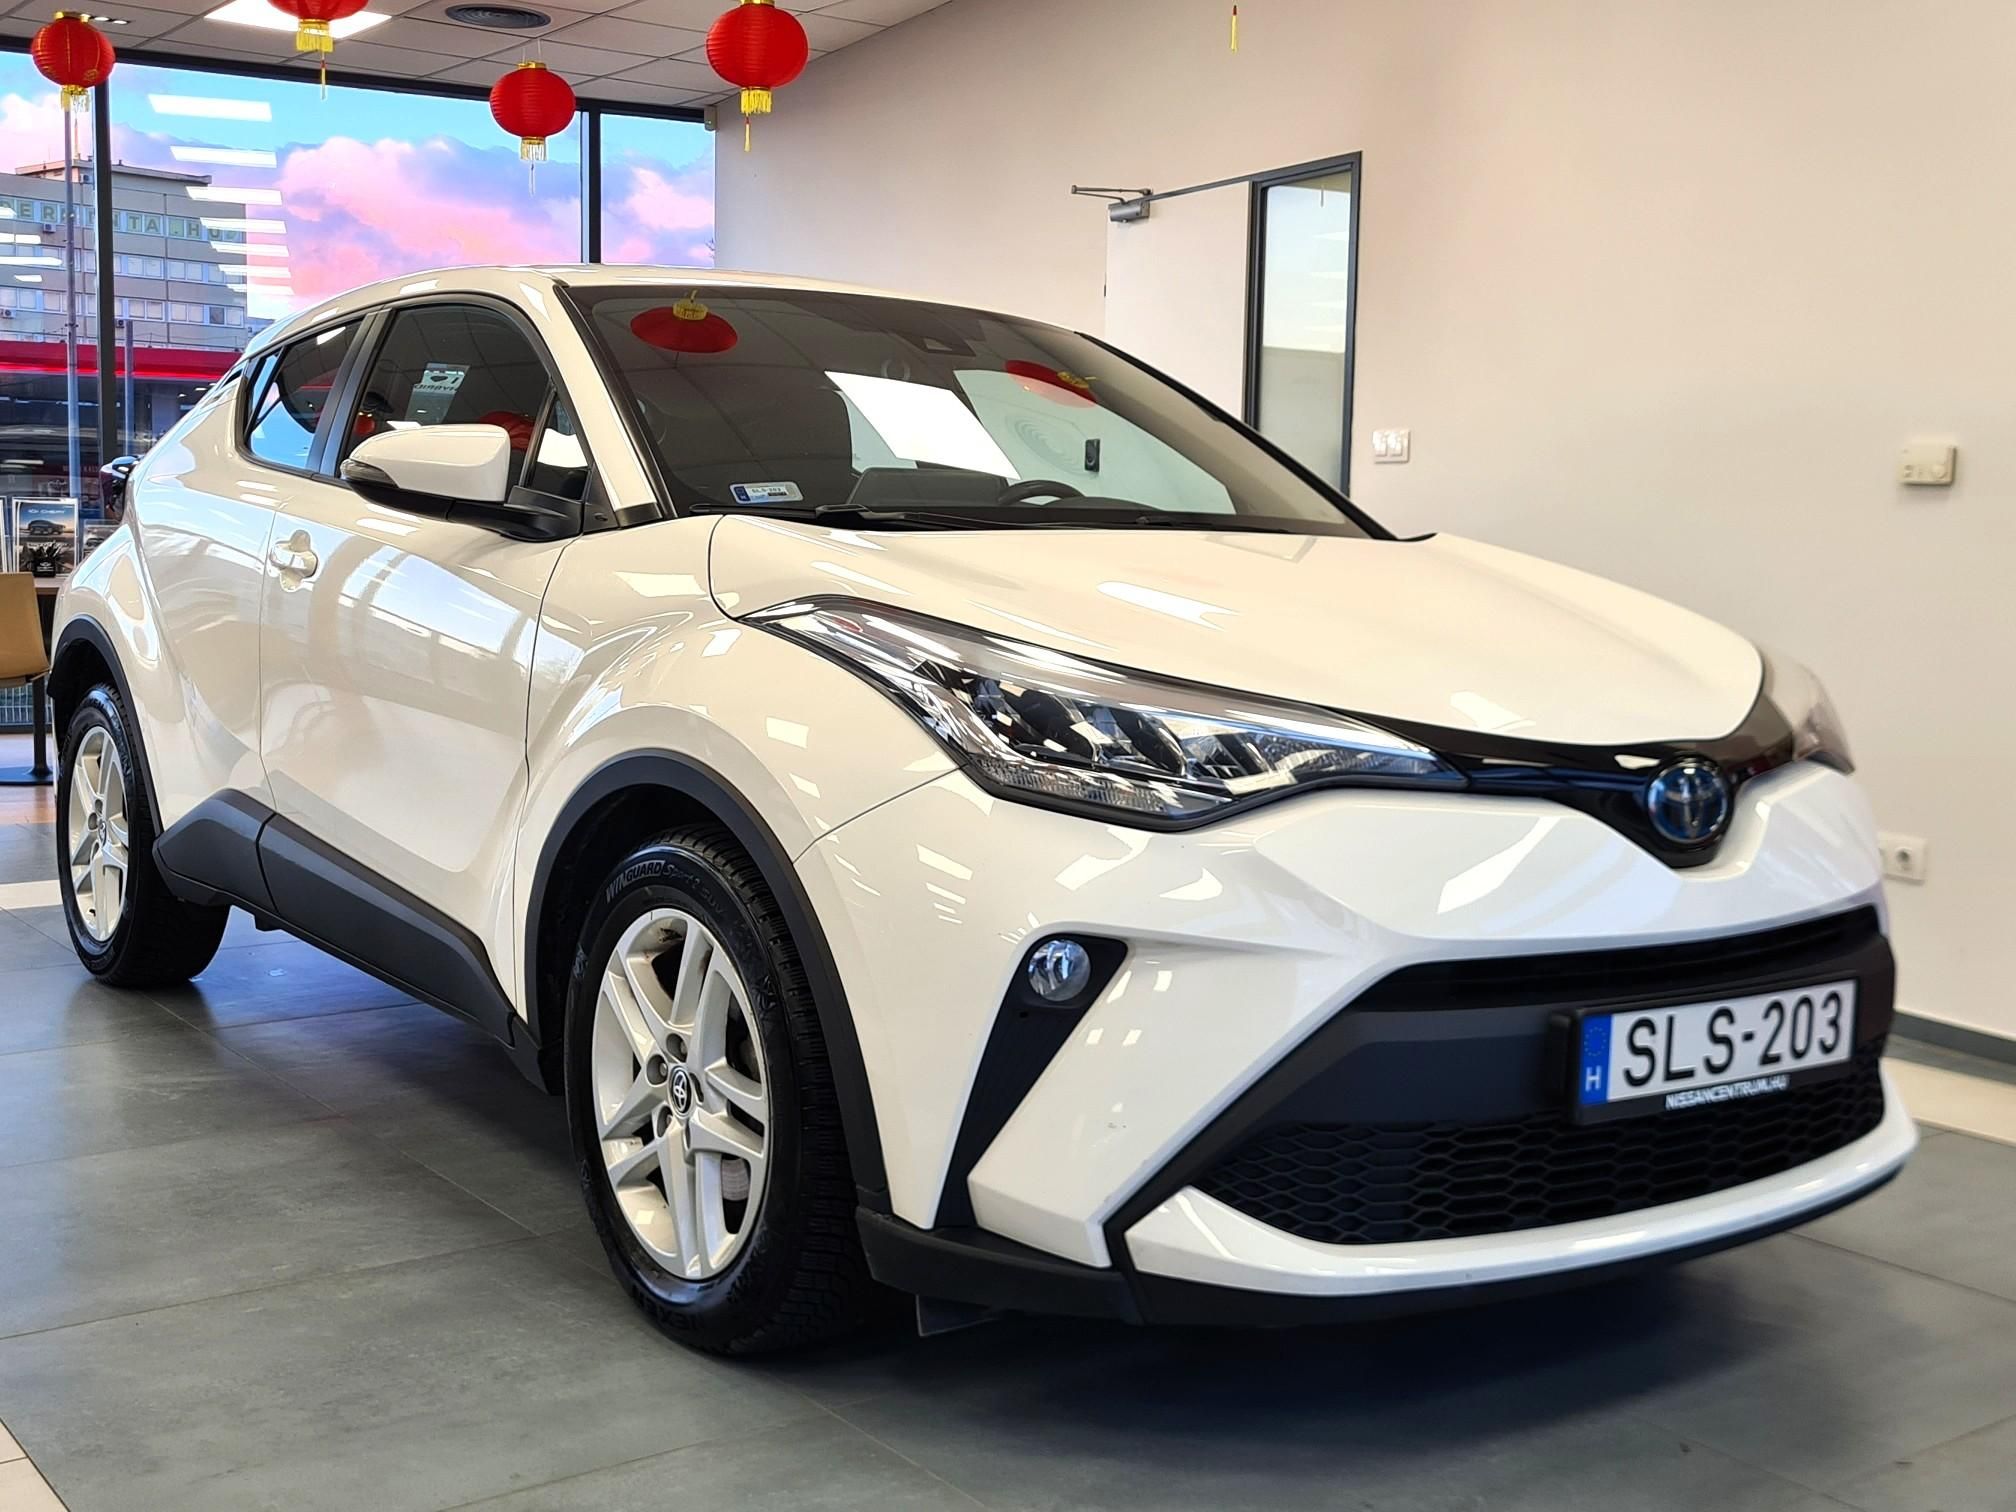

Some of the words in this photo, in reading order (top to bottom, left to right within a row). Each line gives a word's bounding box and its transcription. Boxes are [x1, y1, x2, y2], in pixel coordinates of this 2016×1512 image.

[604, 860, 666, 904] WINGUARD
[1585, 1064, 1602, 1091] H
[1622, 991, 1843, 1087] SLS-203
